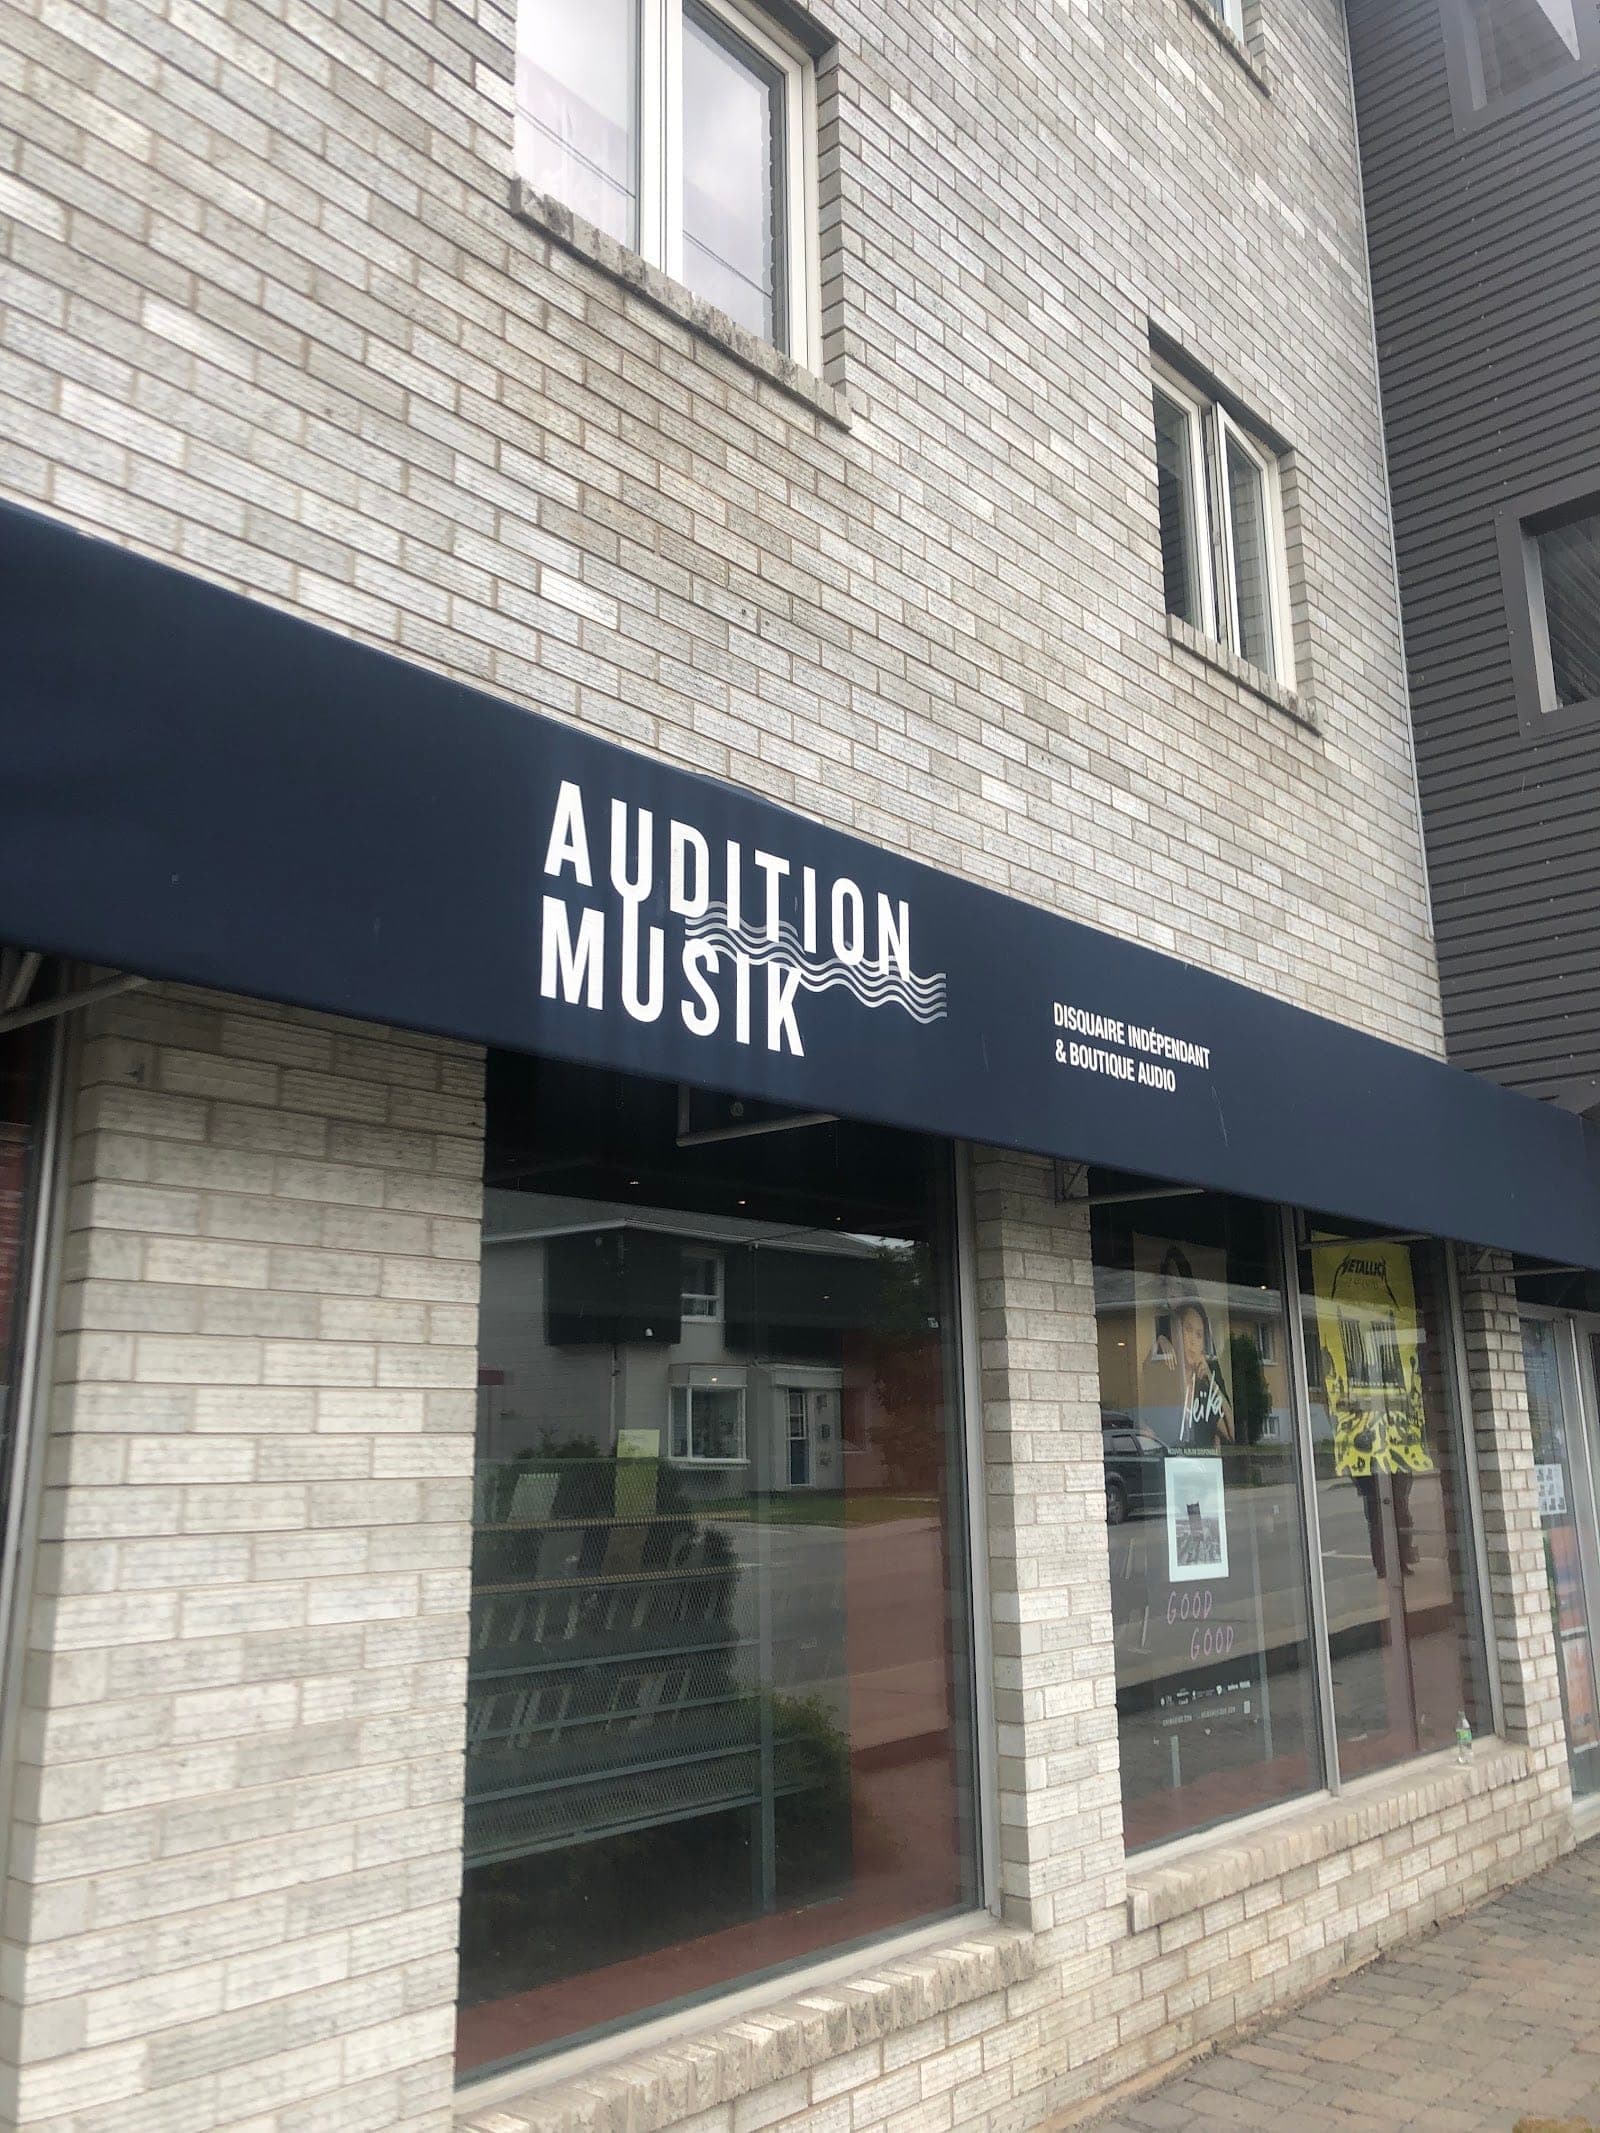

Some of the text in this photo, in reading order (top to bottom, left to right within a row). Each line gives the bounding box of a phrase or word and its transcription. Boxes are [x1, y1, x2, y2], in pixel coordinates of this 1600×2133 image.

[544, 780, 910, 982] AUDITION
[540, 895, 805, 1057] MUSIK
[1053, 1001, 1211, 1070] DISQUAIRE INDÉPENDANT
[1055, 1039, 1177, 1093] & BOUTIQUE AUDIO
[1167, 1590, 1213, 1625] GOOD
[1190, 1625, 1234, 1661] GOOD
